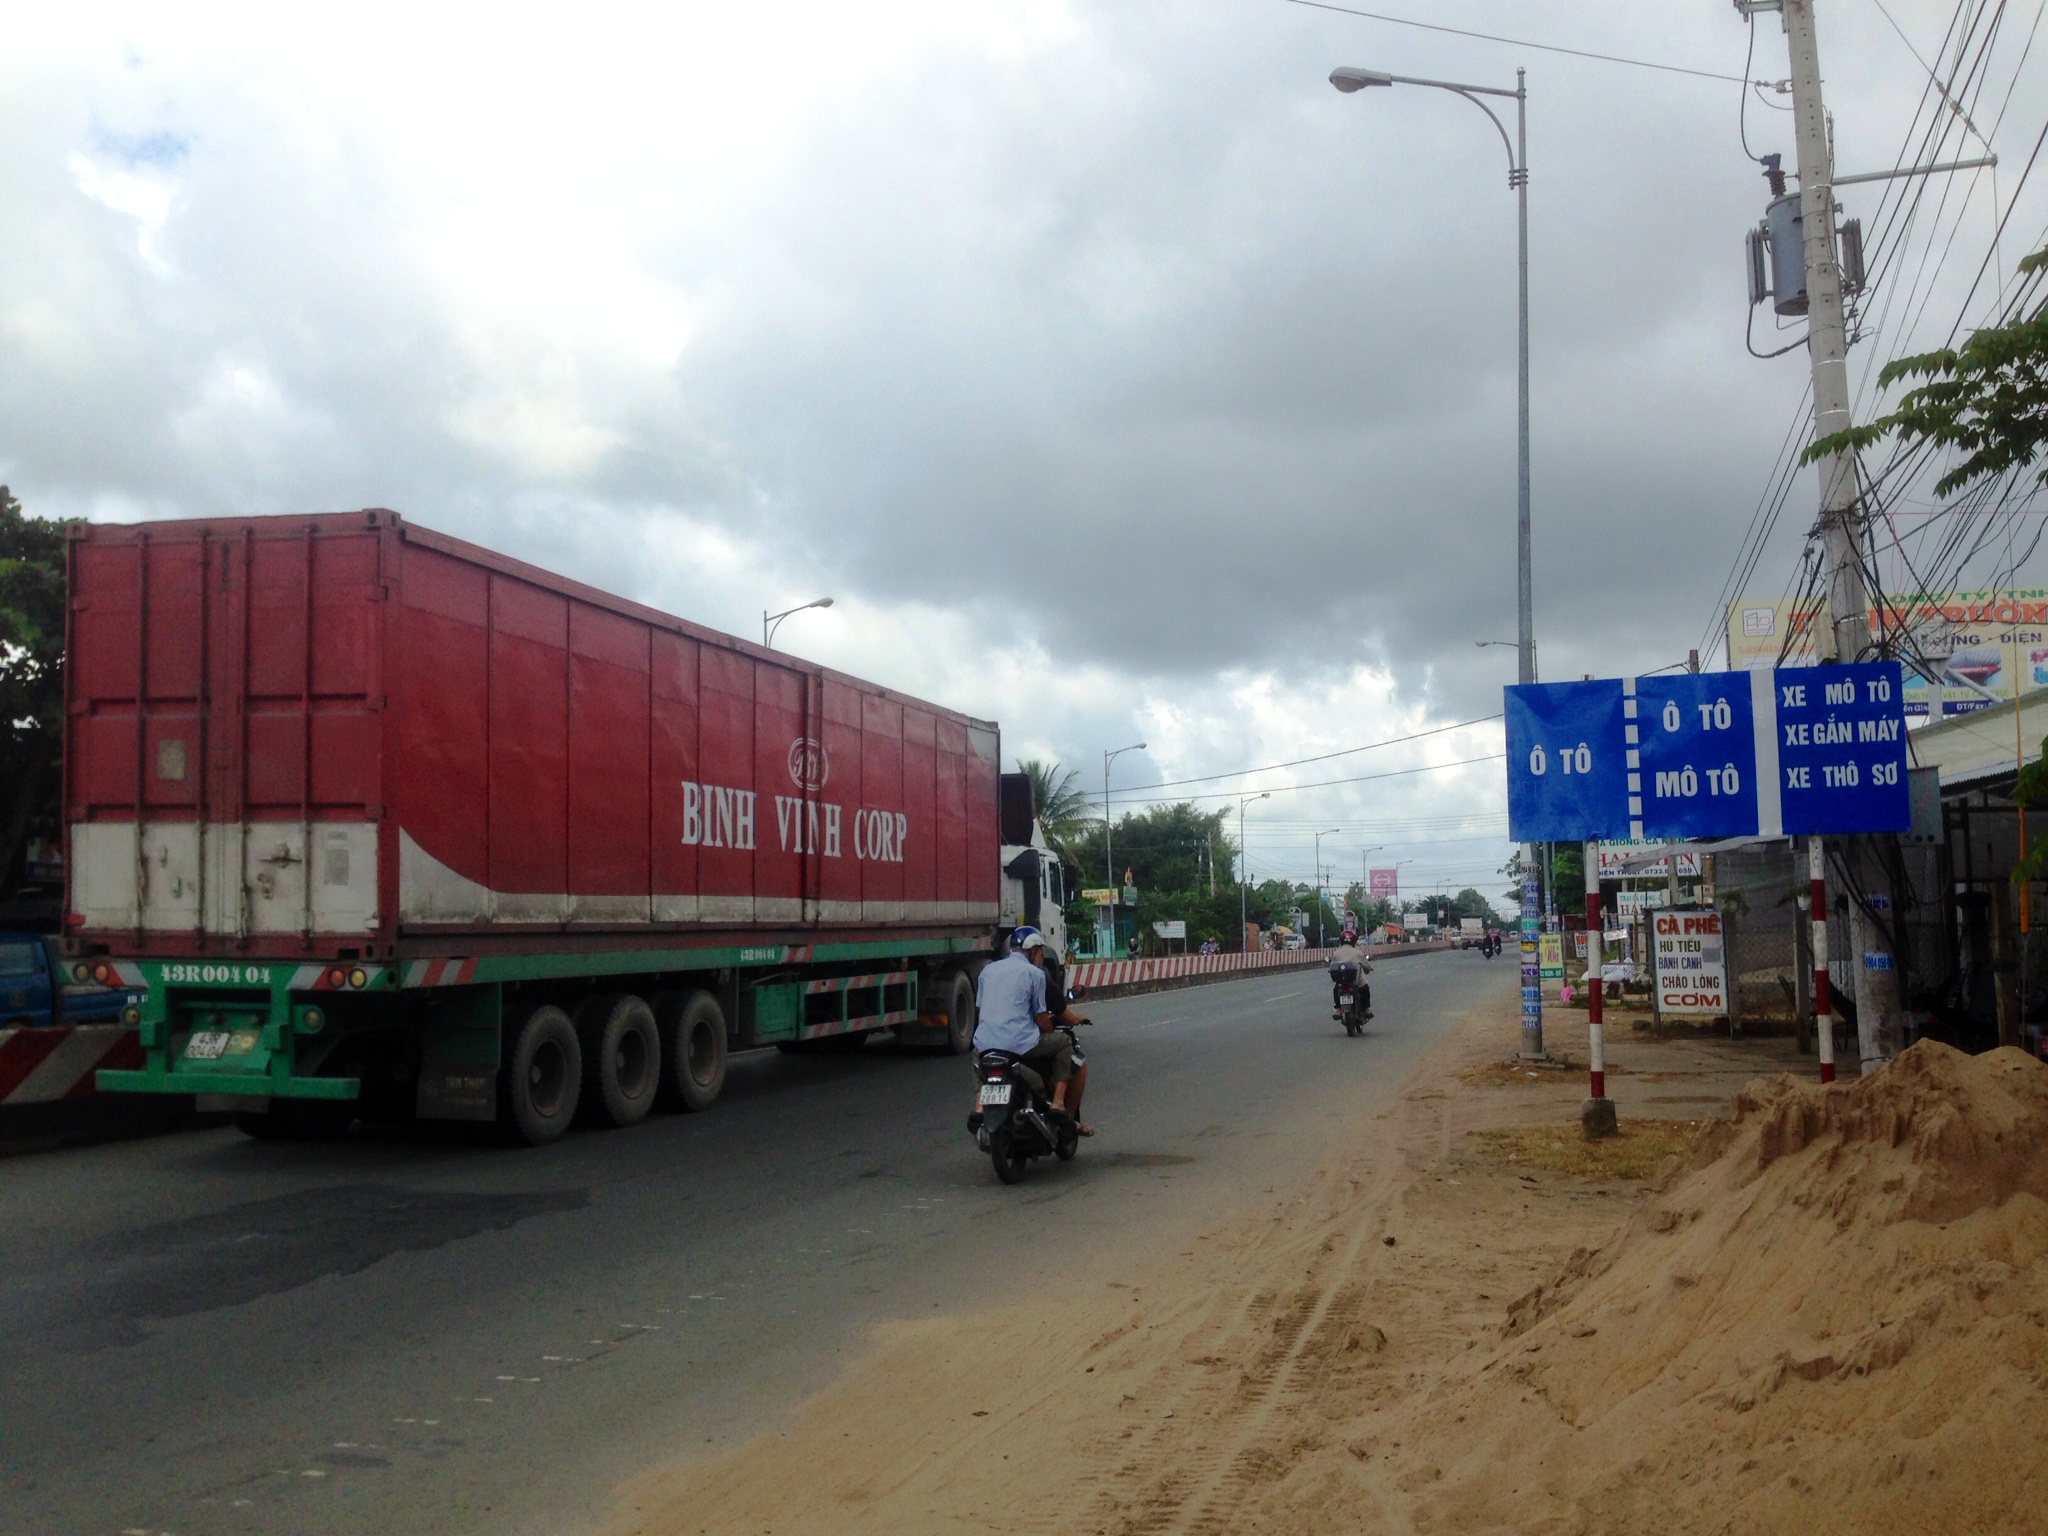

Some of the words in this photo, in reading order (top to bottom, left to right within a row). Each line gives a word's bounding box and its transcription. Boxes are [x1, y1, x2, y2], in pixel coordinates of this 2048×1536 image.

[2001, 630, 2042, 646] ĐIỆN
[1782, 685, 1807, 708] XE
[1825, 677, 1855, 705] MÔ
[1867, 675, 1891, 703] TÔ
[1663, 700, 1681, 732] Ô
[1698, 697, 1732, 731] TÔ
[1785, 724, 1810, 746] XE
[1813, 713, 1853, 745] GẮN
[1858, 714, 1900, 743] MÁY
[1530, 744, 1547, 775] Ô
[1559, 742, 1592, 775] TÔ
[1656, 764, 1698, 798] MÔ
[1706, 762, 1740, 796] TÔ
[1786, 767, 1811, 789] XE
[1822, 760, 1859, 788] THÔ
[1871, 761, 1898, 786] SƠ
[681, 780, 757, 850] BINH
[774, 795, 842, 858] VINH
[854, 808, 907, 863] CORP
[1656, 914, 1680, 935] CÀ
[1683, 913, 1721, 936] PHÊ
[1677, 938, 1701, 953] TIẾU
[1658, 955, 1679, 970] BÁNH
[1681, 957, 1702, 970] CANH
[1662, 973, 1688, 989] CHÁO
[1692, 974, 1720, 989] LÒNG
[1663, 992, 1721, 1007] CƠM
